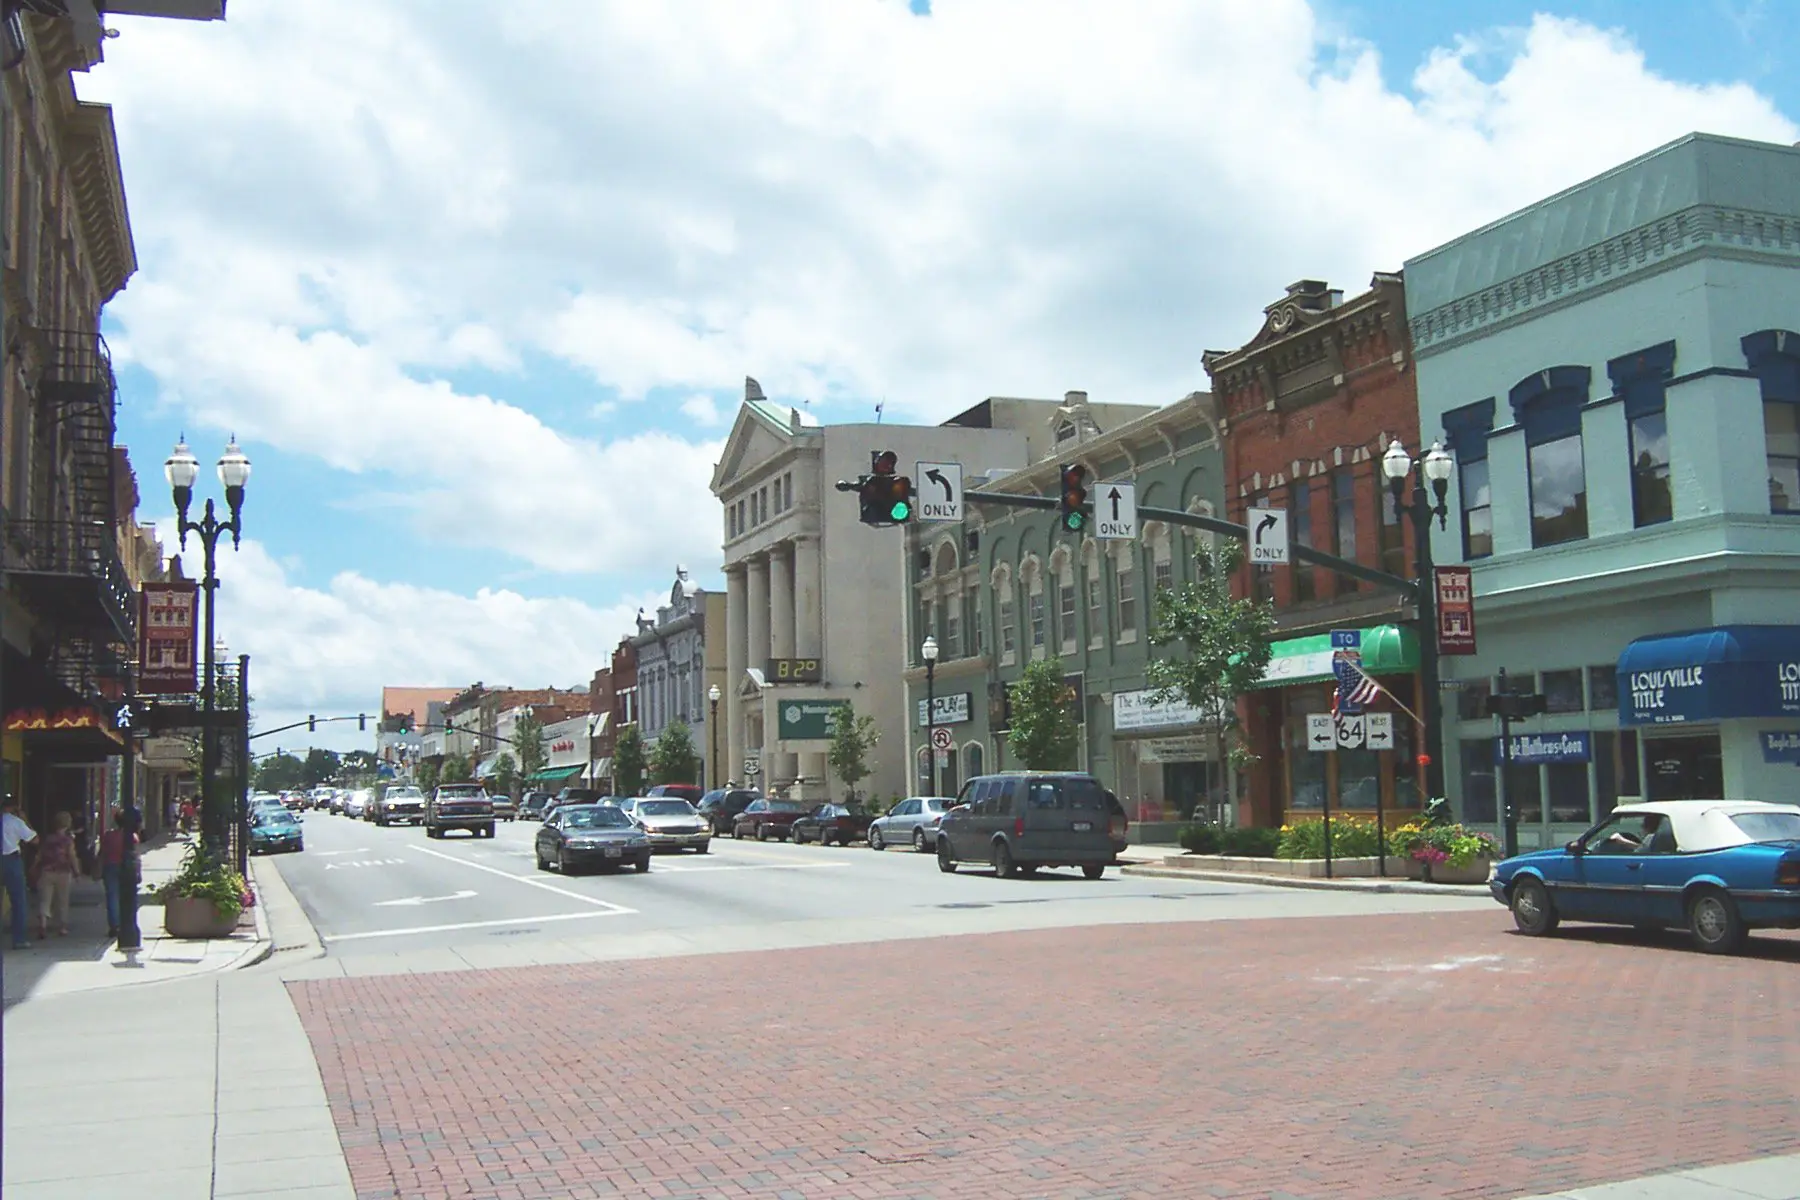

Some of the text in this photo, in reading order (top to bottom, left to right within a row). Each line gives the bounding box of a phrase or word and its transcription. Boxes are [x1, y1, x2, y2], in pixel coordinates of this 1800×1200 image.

[924, 504, 957, 517] ONLY
[1101, 523, 1132, 535] ONLY
[1255, 547, 1284, 559] ONLY
[1338, 633, 1353, 643] TO
[1631, 666, 1703, 691] LOUISVILLE
[1632, 689, 1665, 709] TITLE
[1312, 718, 1329, 728] EAST
[1339, 721, 1362, 742] 64
